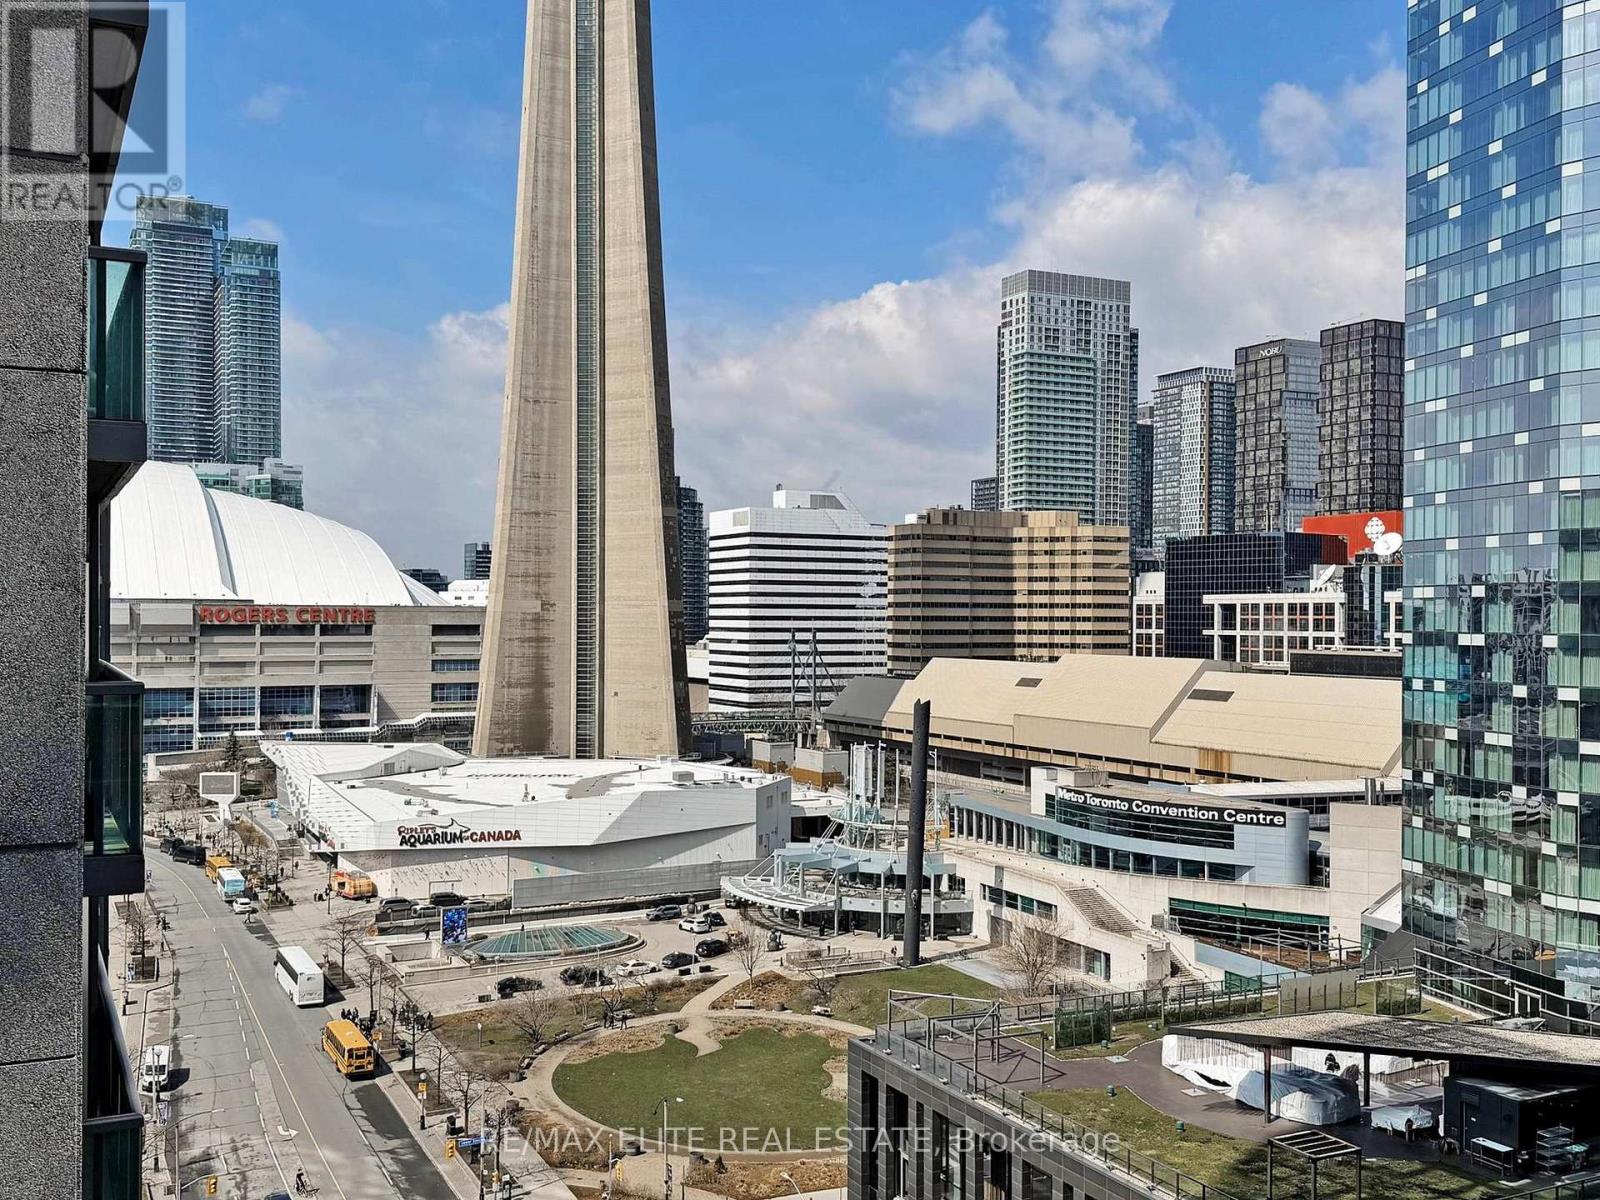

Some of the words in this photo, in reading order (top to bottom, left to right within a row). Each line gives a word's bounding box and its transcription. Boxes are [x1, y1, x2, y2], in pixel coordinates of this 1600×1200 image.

[1258, 346, 1282, 357] NOBU
[200, 607, 289, 623] ROGERS
[295, 607, 377, 624] CENTRE
[1058, 787, 1085, 804] Metro
[1084, 794, 1129, 811] Toronto
[1132, 801, 1218, 821] Convention
[1224, 809, 1285, 825] Centre
[399, 830, 464, 848] AQUARIUM
[469, 830, 522, 843] CANADA
